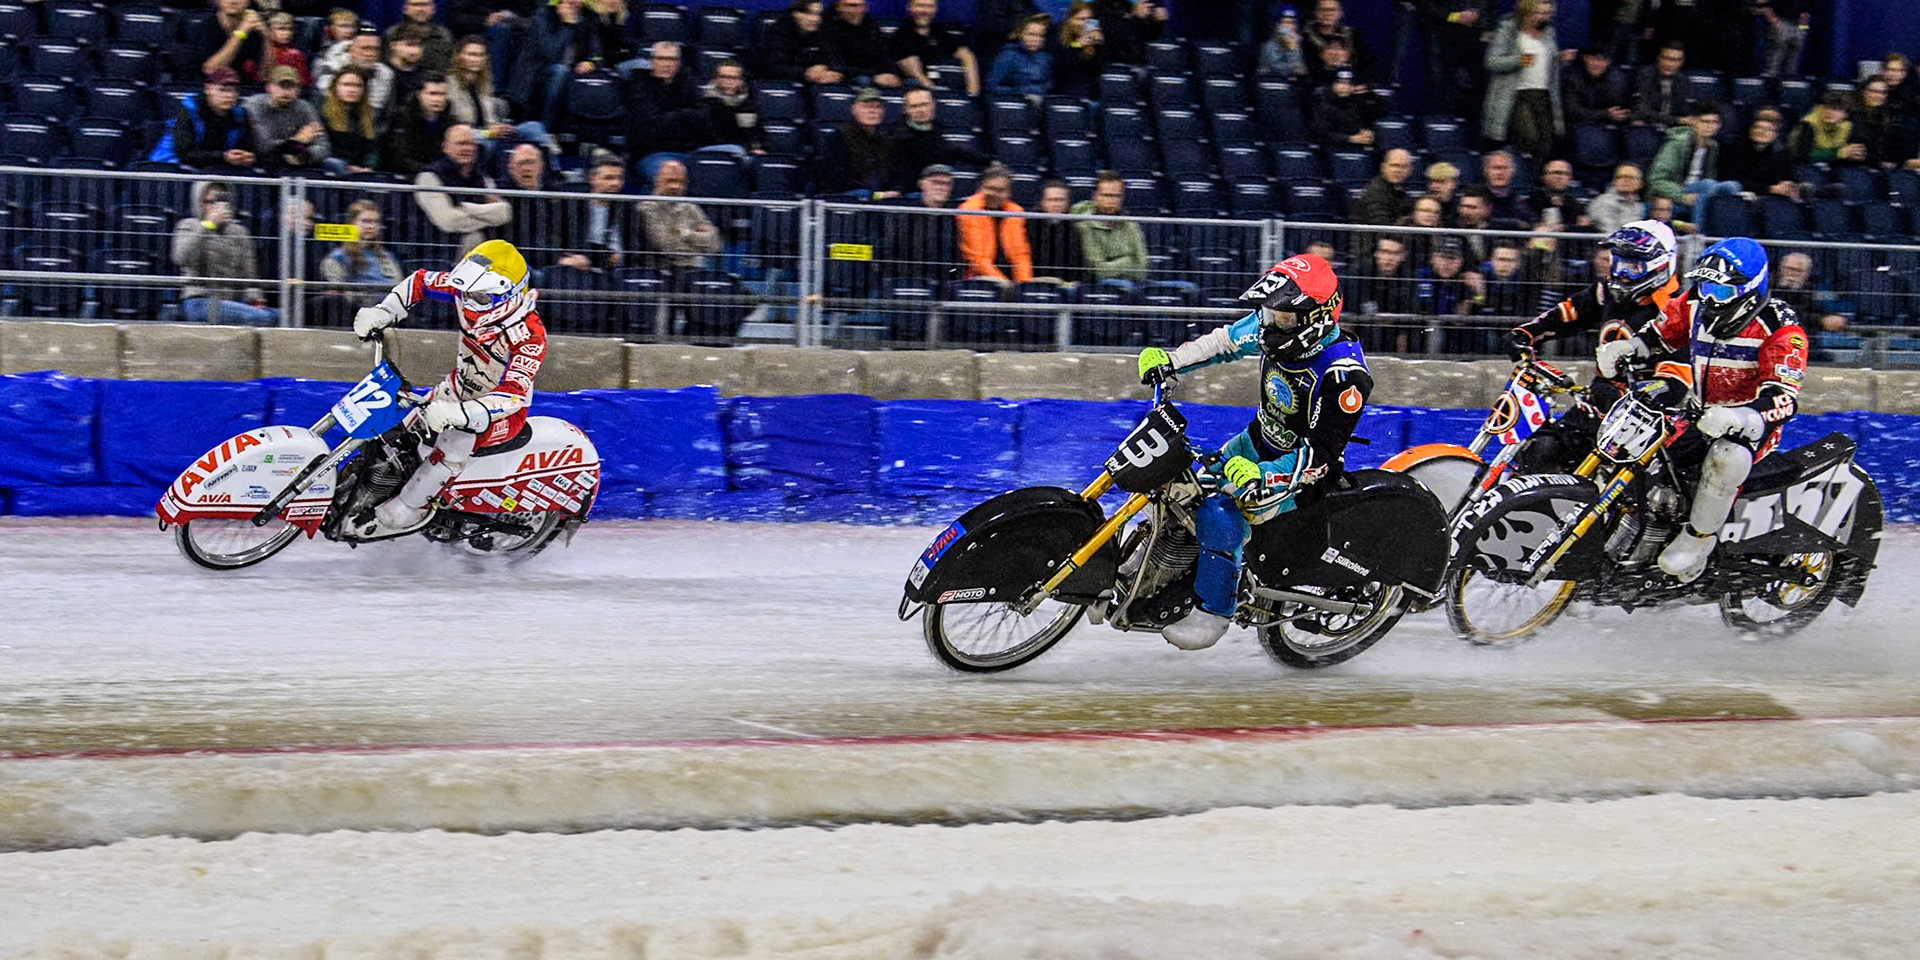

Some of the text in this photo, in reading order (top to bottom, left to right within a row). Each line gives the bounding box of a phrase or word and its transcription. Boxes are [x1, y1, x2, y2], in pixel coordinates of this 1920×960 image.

[181, 433, 262, 498] AVIA
[1334, 555, 1371, 577] Silkolene
[955, 590, 983, 599] MOTO
